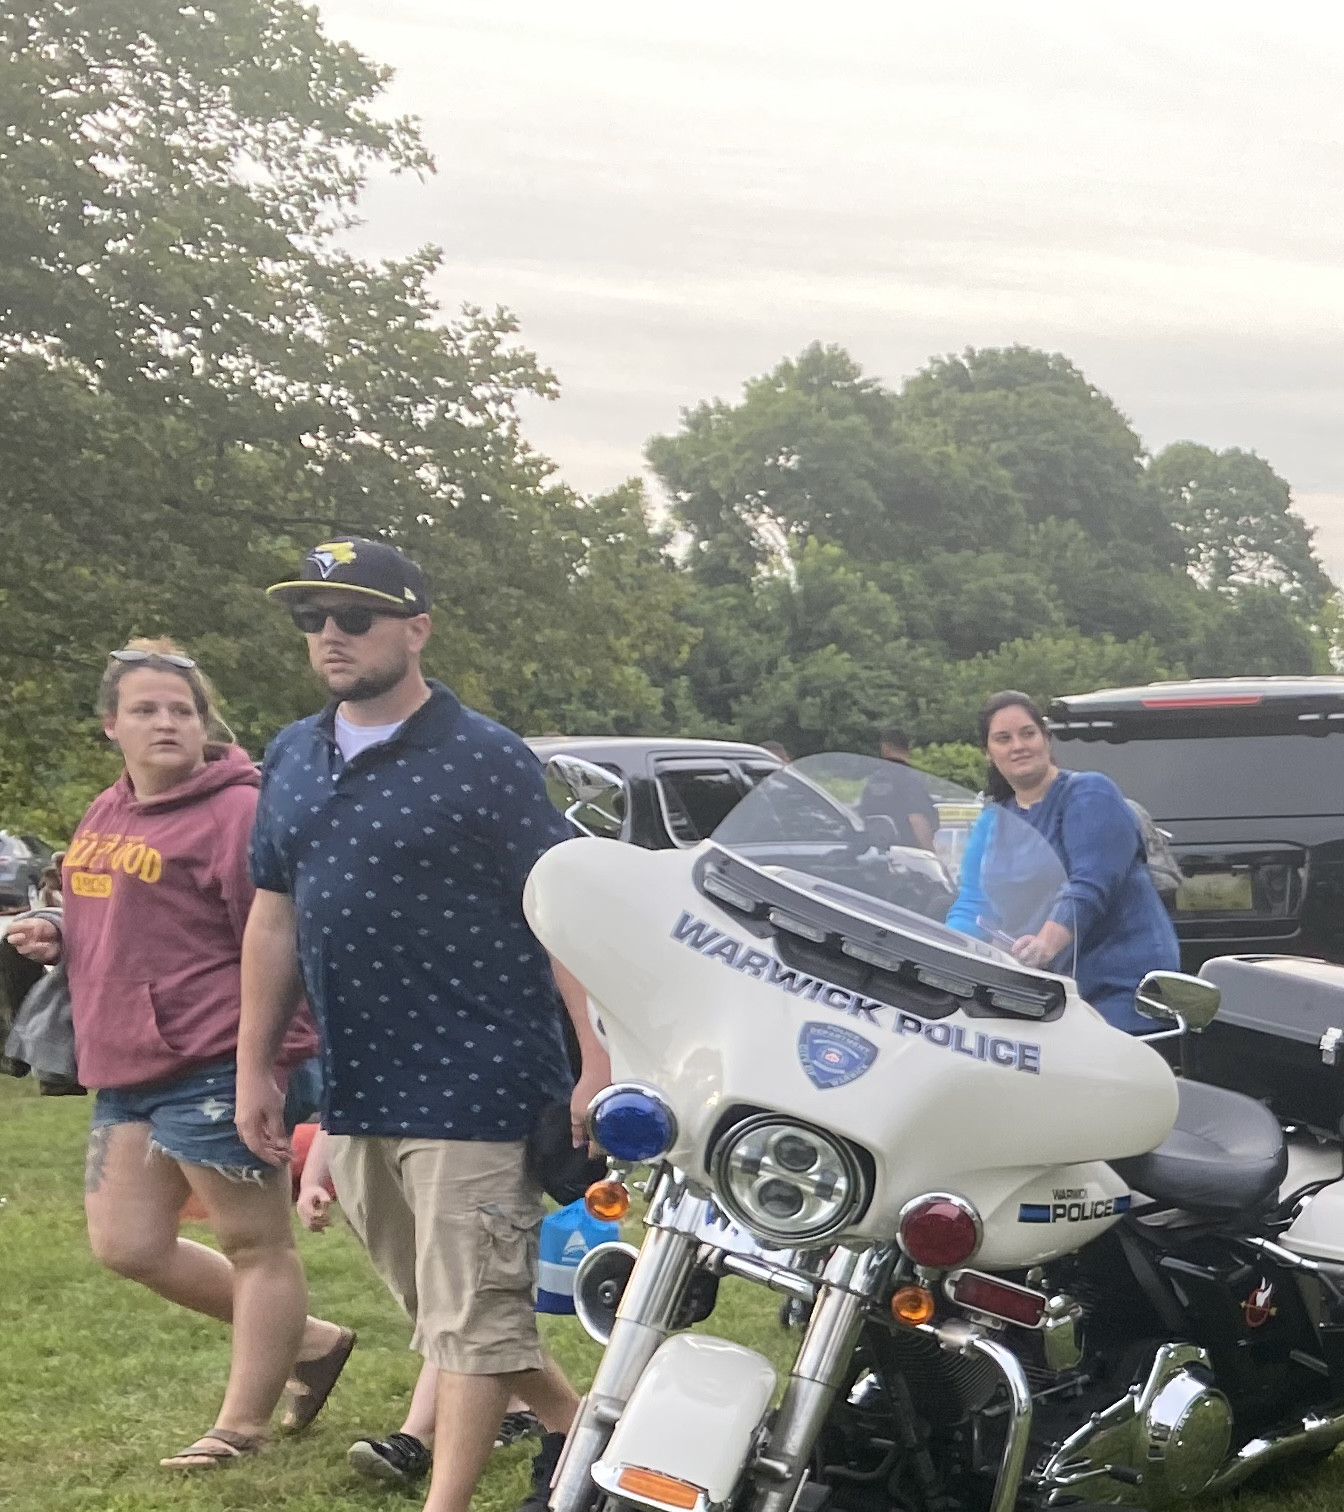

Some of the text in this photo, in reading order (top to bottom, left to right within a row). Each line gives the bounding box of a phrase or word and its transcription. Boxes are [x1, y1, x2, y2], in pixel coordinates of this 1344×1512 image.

[669, 908, 1041, 1075] WARWICK POLICE
[1052, 1199, 1113, 1223] POLICE
